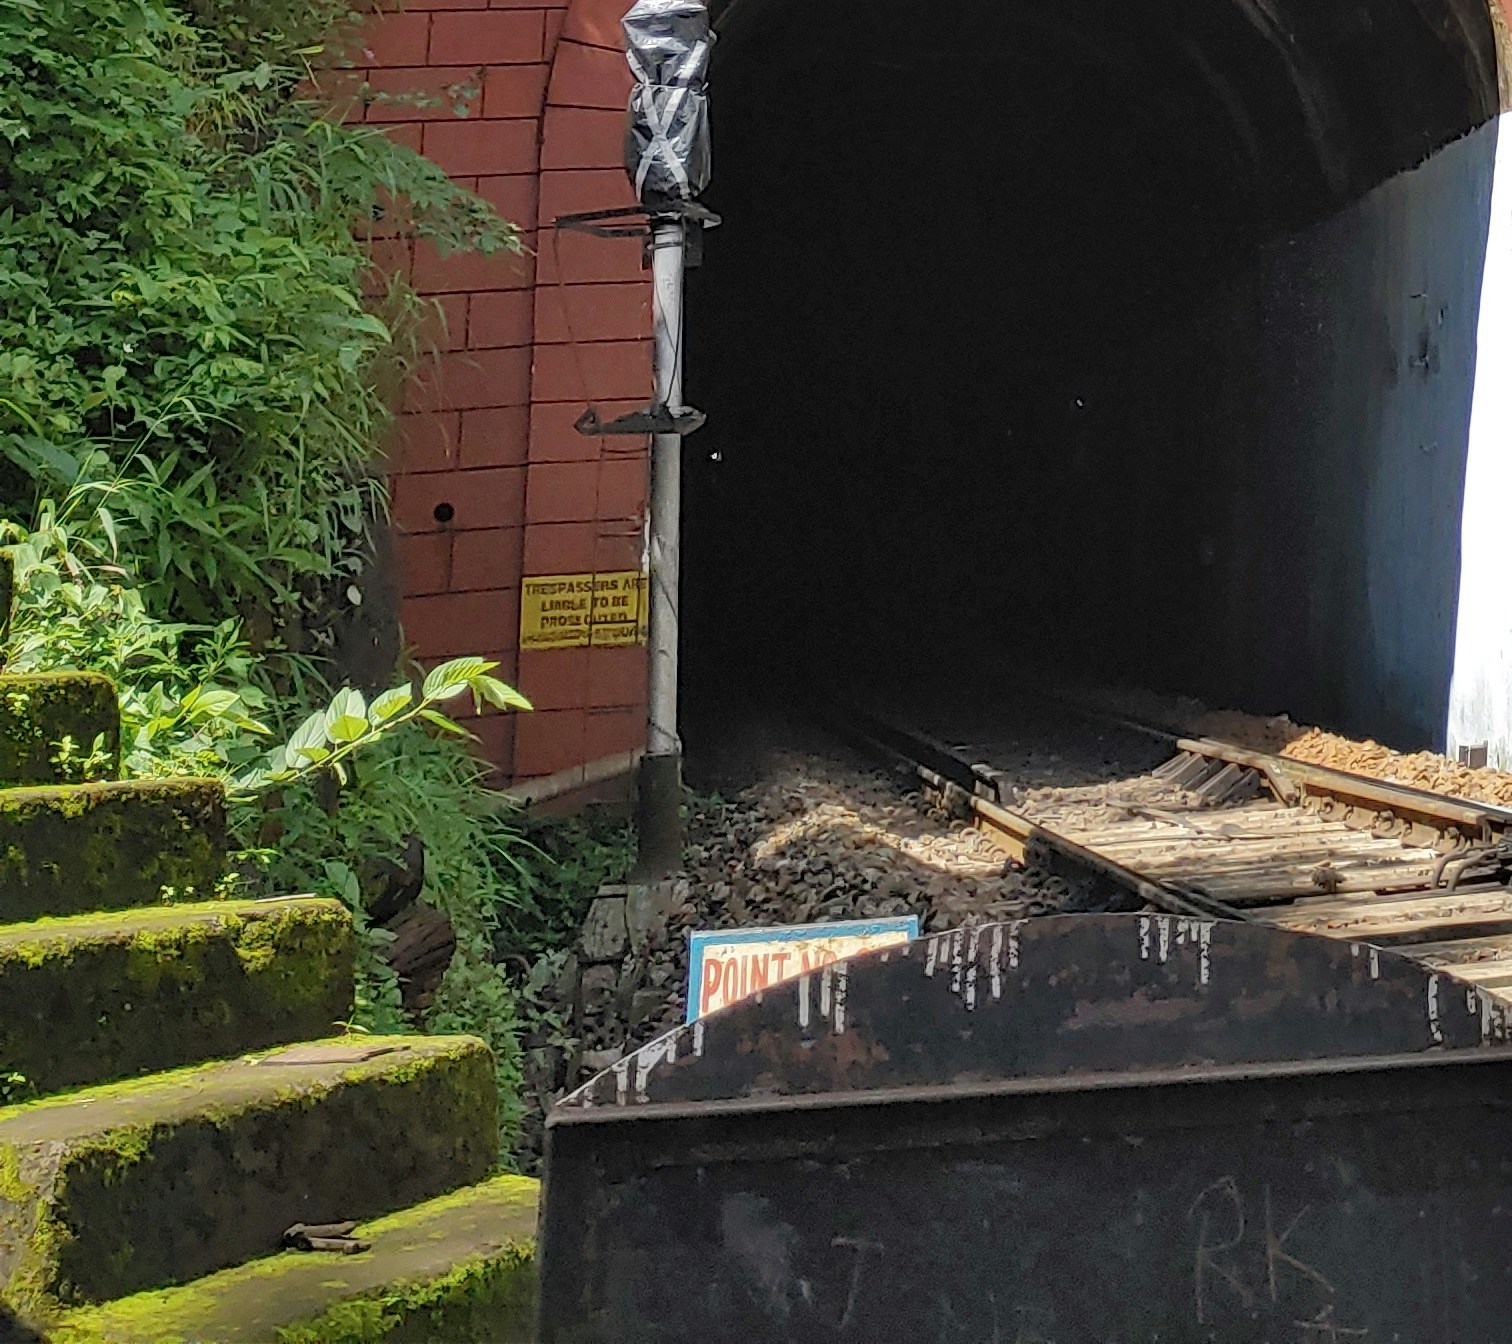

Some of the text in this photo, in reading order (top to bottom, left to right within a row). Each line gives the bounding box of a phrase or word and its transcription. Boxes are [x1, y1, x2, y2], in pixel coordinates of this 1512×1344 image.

[525, 577, 648, 596] TRESPASSERS ARE
[592, 596, 609, 608] TO
[701, 952, 792, 1014] POINT
